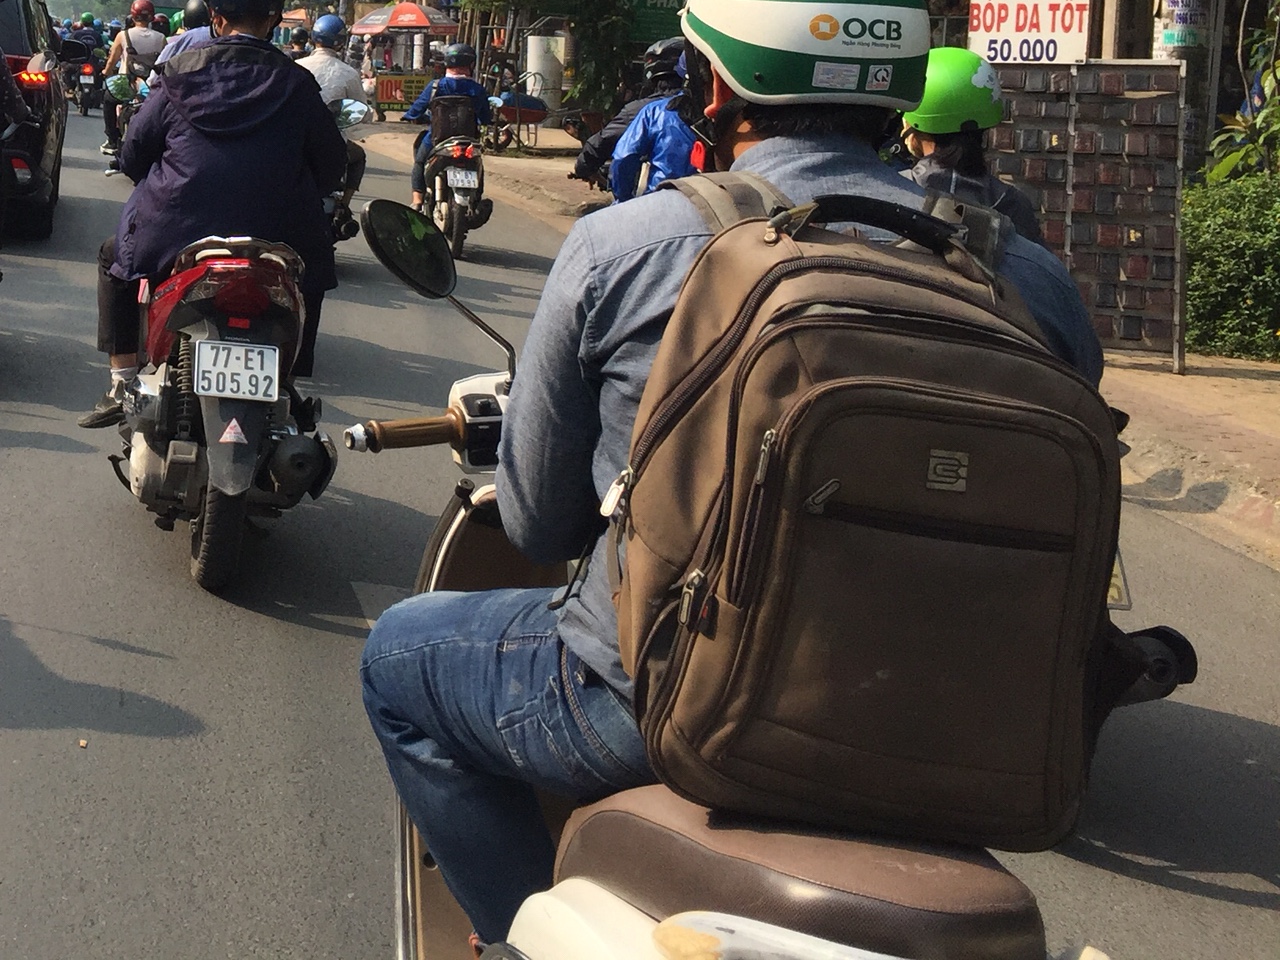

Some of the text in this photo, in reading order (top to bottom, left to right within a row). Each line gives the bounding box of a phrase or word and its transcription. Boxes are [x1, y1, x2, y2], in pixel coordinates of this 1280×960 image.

[843, 17, 902, 41] OCB
[1015, 3, 1041, 33] DA
[987, 39, 1058, 62] 50.000
[210, 345, 265, 371] 77-E1
[201, 370, 273, 398] 505.92
